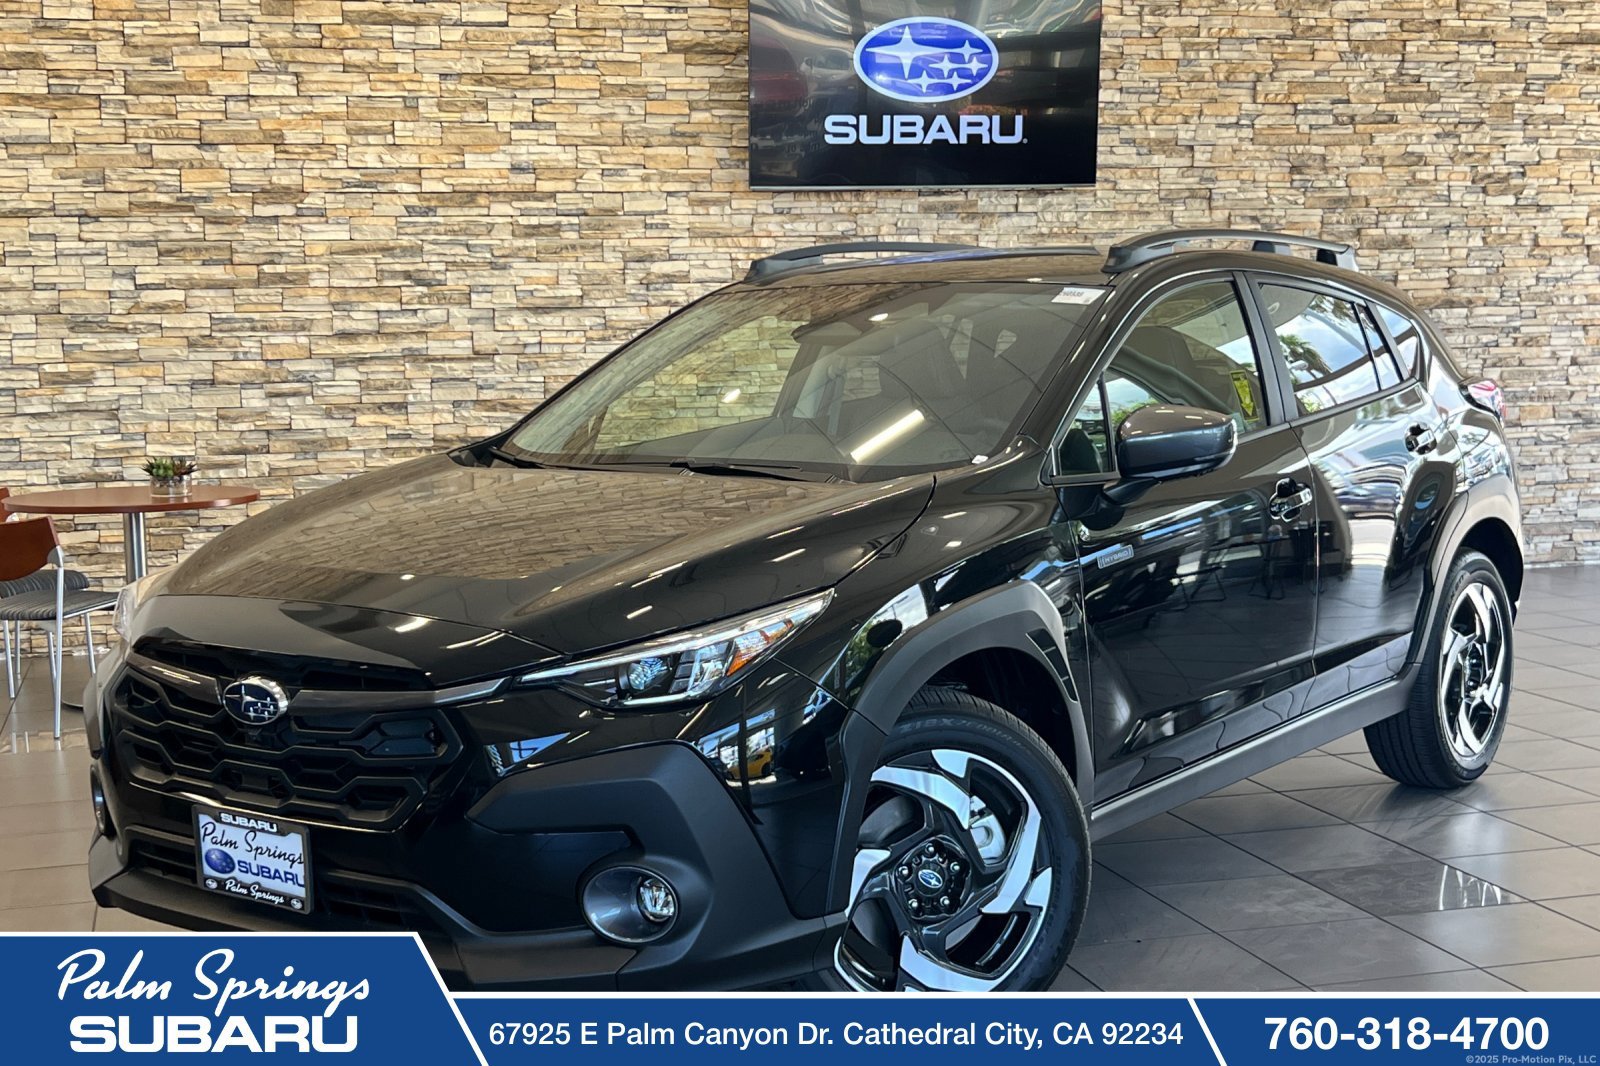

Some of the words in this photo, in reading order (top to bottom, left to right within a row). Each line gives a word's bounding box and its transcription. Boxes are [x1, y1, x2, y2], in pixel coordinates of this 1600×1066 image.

[824, 115, 1023, 145] SUBARU
[220, 812, 278, 833] SUBARU
[201, 821, 239, 850] Palm
[244, 829, 304, 869] Springs
[225, 879, 249, 895] Palm
[250, 884, 285, 905] Springs
